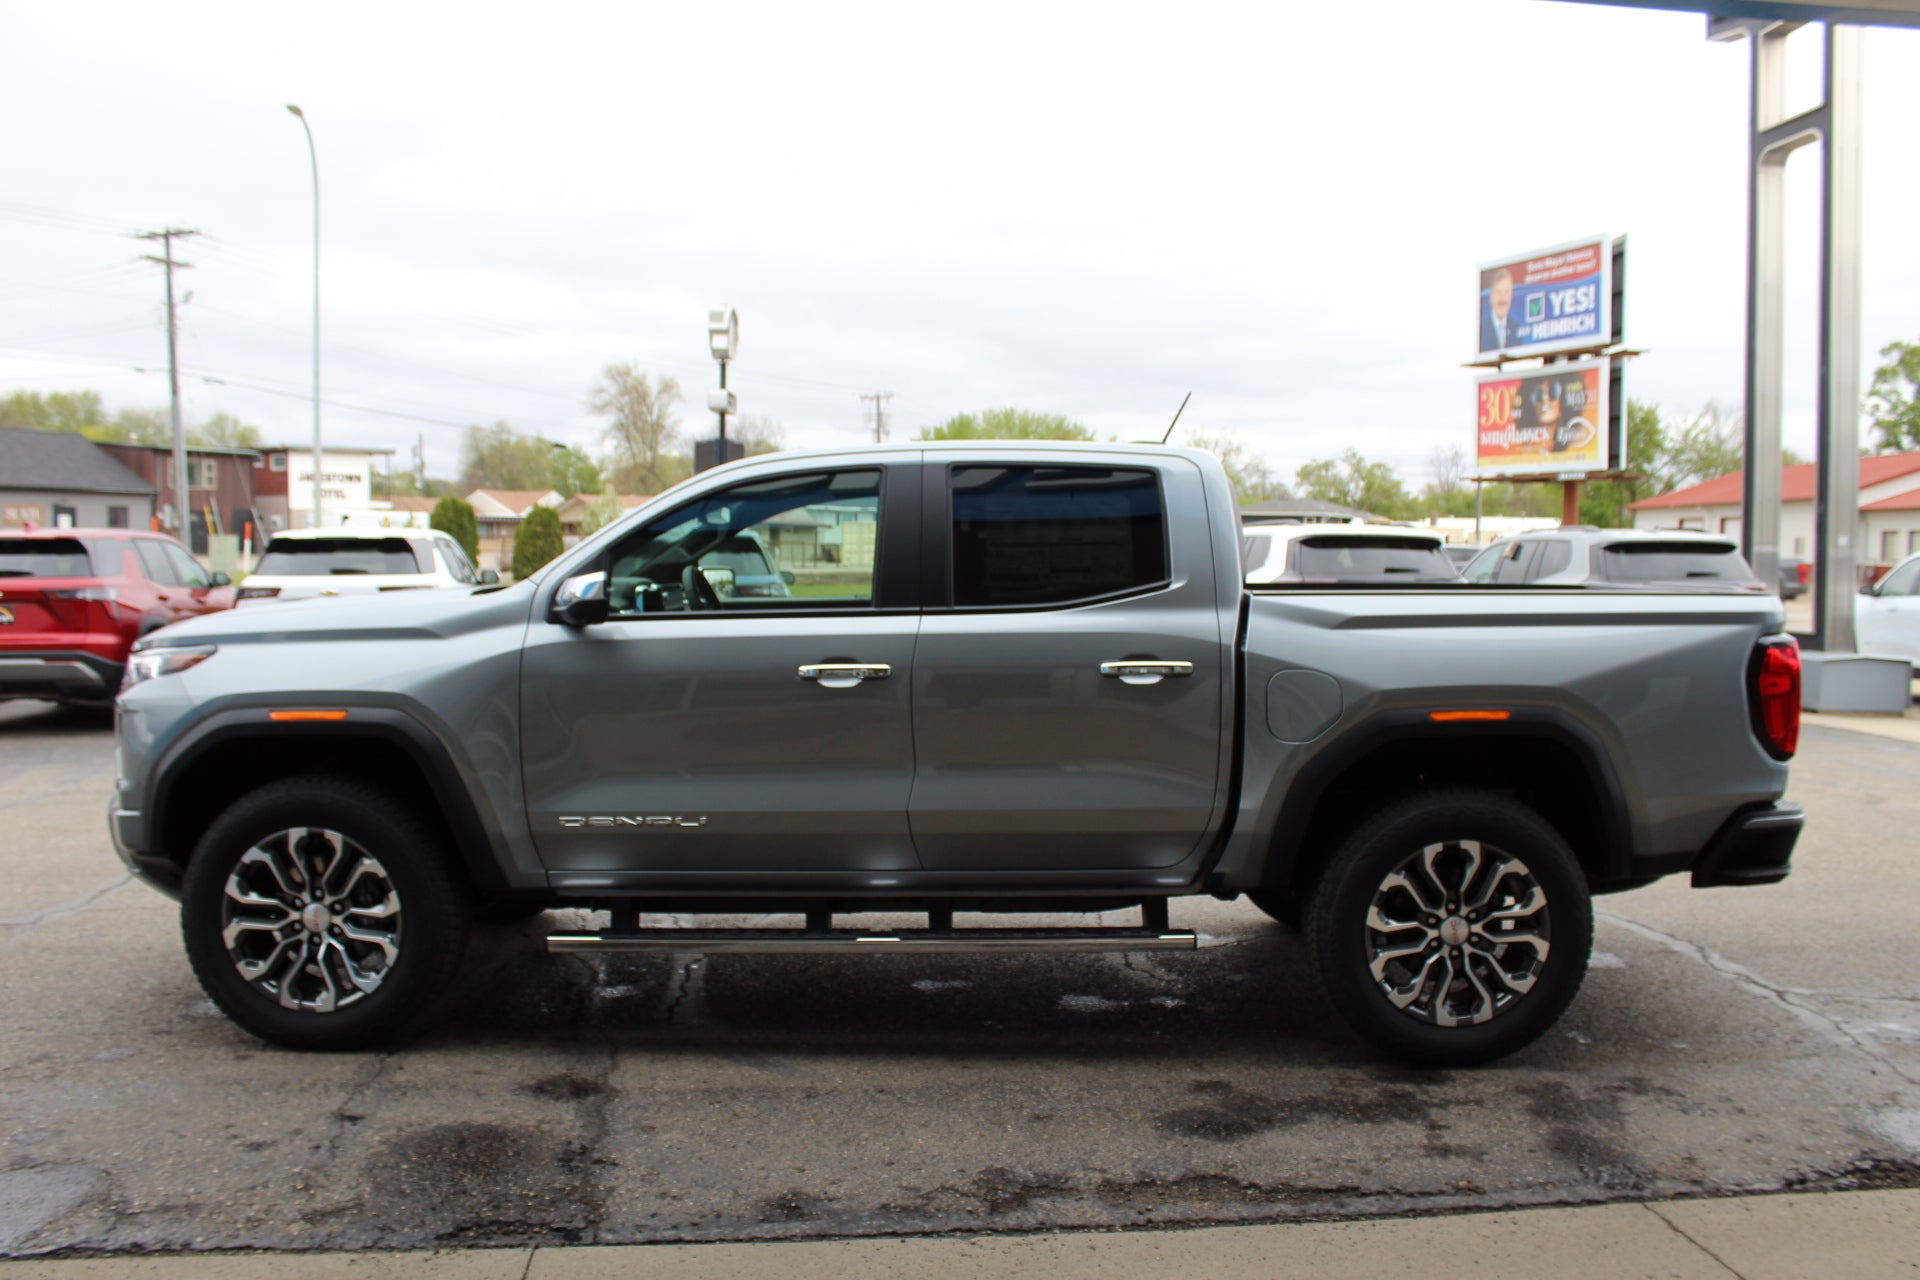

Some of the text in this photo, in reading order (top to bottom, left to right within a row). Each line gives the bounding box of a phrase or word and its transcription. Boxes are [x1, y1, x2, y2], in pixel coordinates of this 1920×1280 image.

[1549, 283, 1596, 317] YES!
[1532, 312, 1596, 341] HEINRICH
[315, 488, 347, 499] OTEL
[558, 815, 708, 827] DENALI
